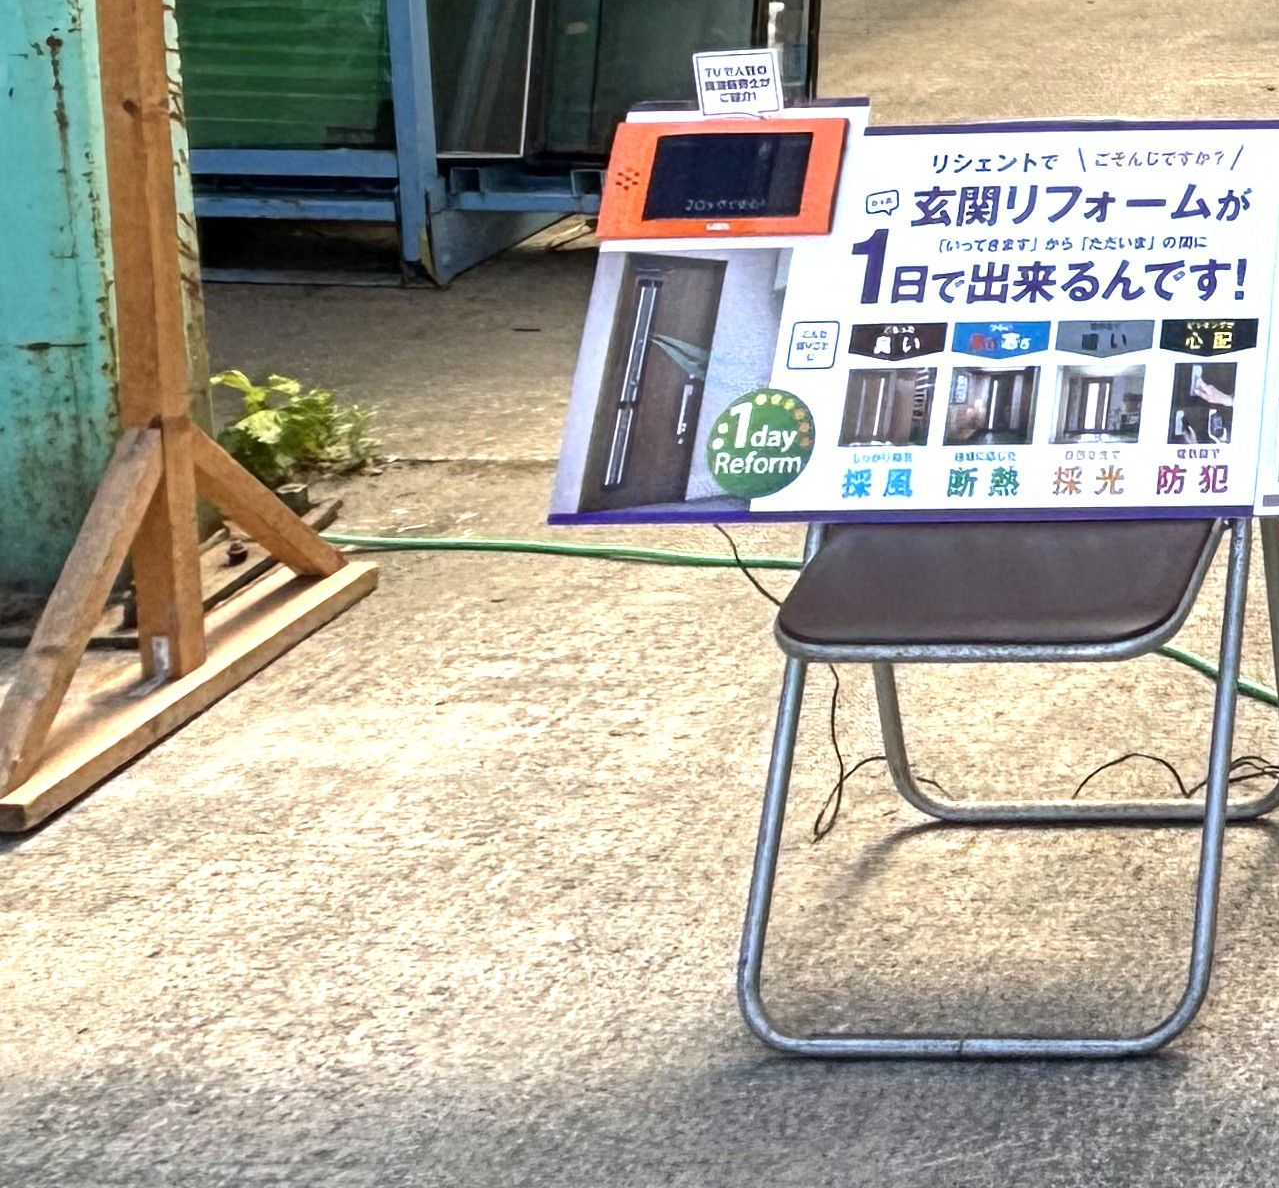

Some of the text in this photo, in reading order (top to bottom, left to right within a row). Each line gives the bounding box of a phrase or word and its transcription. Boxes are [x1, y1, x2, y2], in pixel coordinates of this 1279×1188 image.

[932, 153, 1059, 174] リシェントで
[910, 183, 1252, 228] 玄関リフォームが
[715, 452, 802, 476] Reform
[841, 465, 1229, 499] 採風 断熱 採光 防犯
